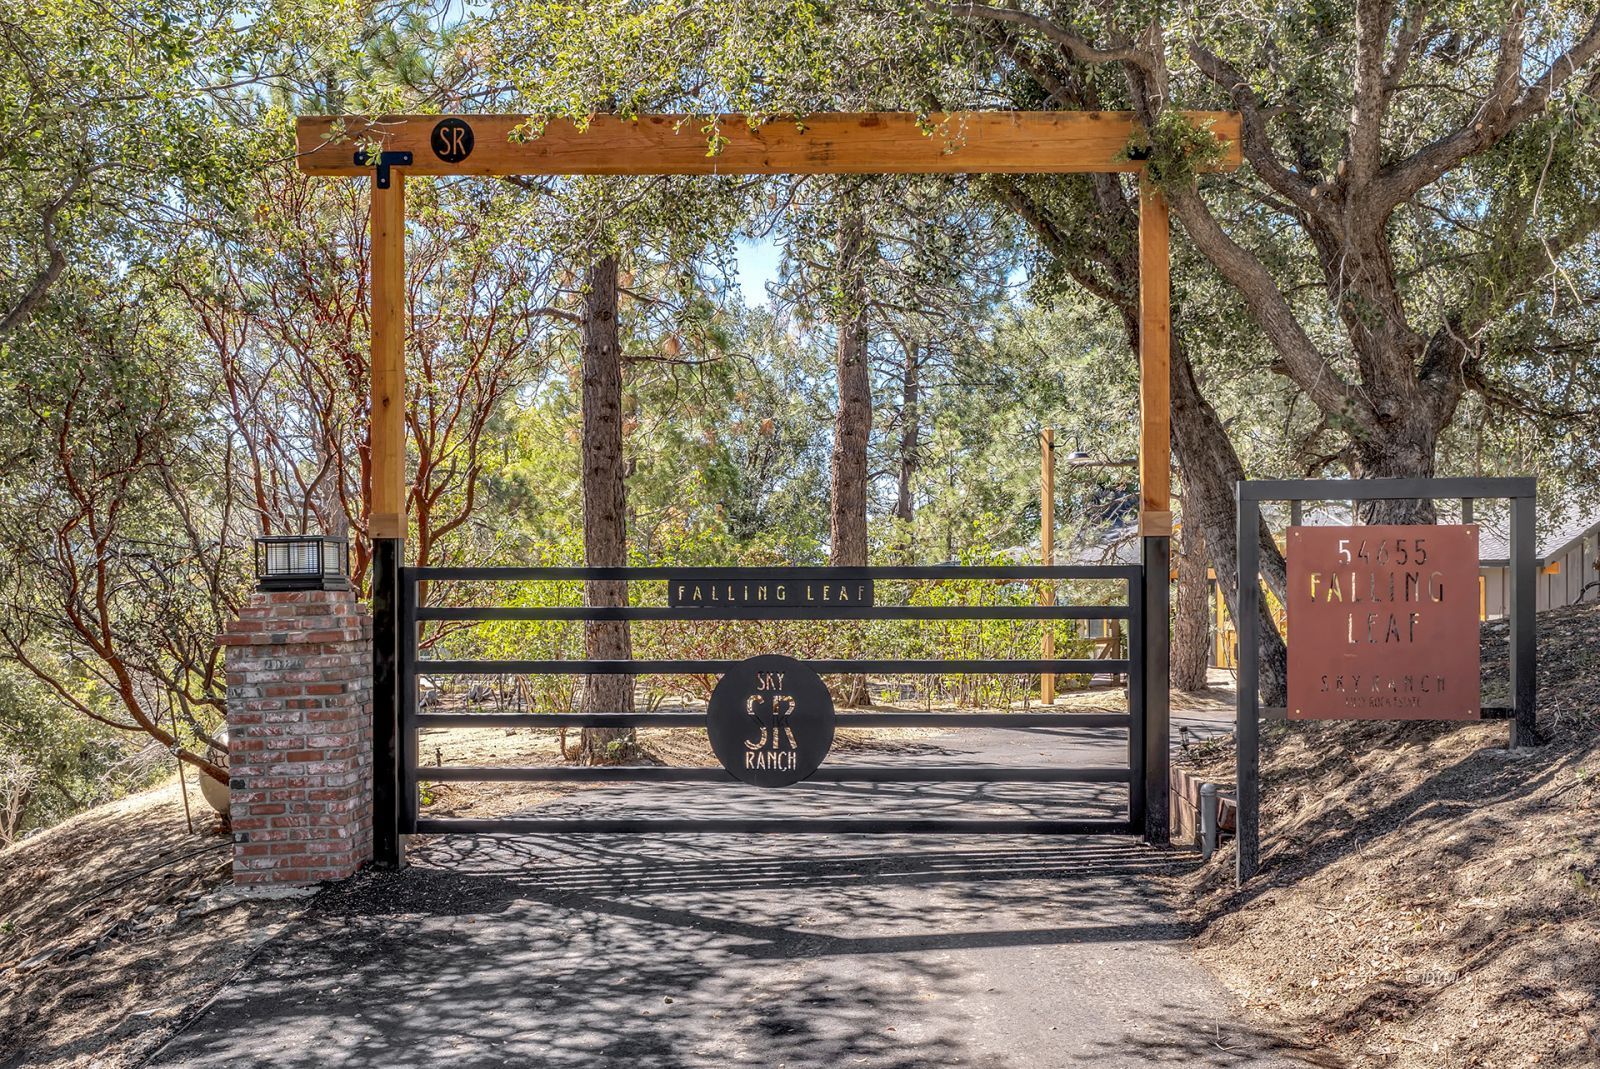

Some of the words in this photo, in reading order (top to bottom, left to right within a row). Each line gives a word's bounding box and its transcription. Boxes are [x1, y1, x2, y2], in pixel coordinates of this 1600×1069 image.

[439, 127, 466, 155] SR
[1338, 539, 1427, 565] 54655
[678, 585, 786, 600] FALLING
[807, 585, 864, 600] LEAF
[1310, 572, 1443, 602] FALLING
[1348, 613, 1420, 643] LEAF
[757, 673, 785, 691] SKY
[1321, 675, 1361, 692] SKY
[1372, 675, 1445, 693] RANCH
[744, 694, 798, 750] SR
[746, 751, 797, 771] RANCH
